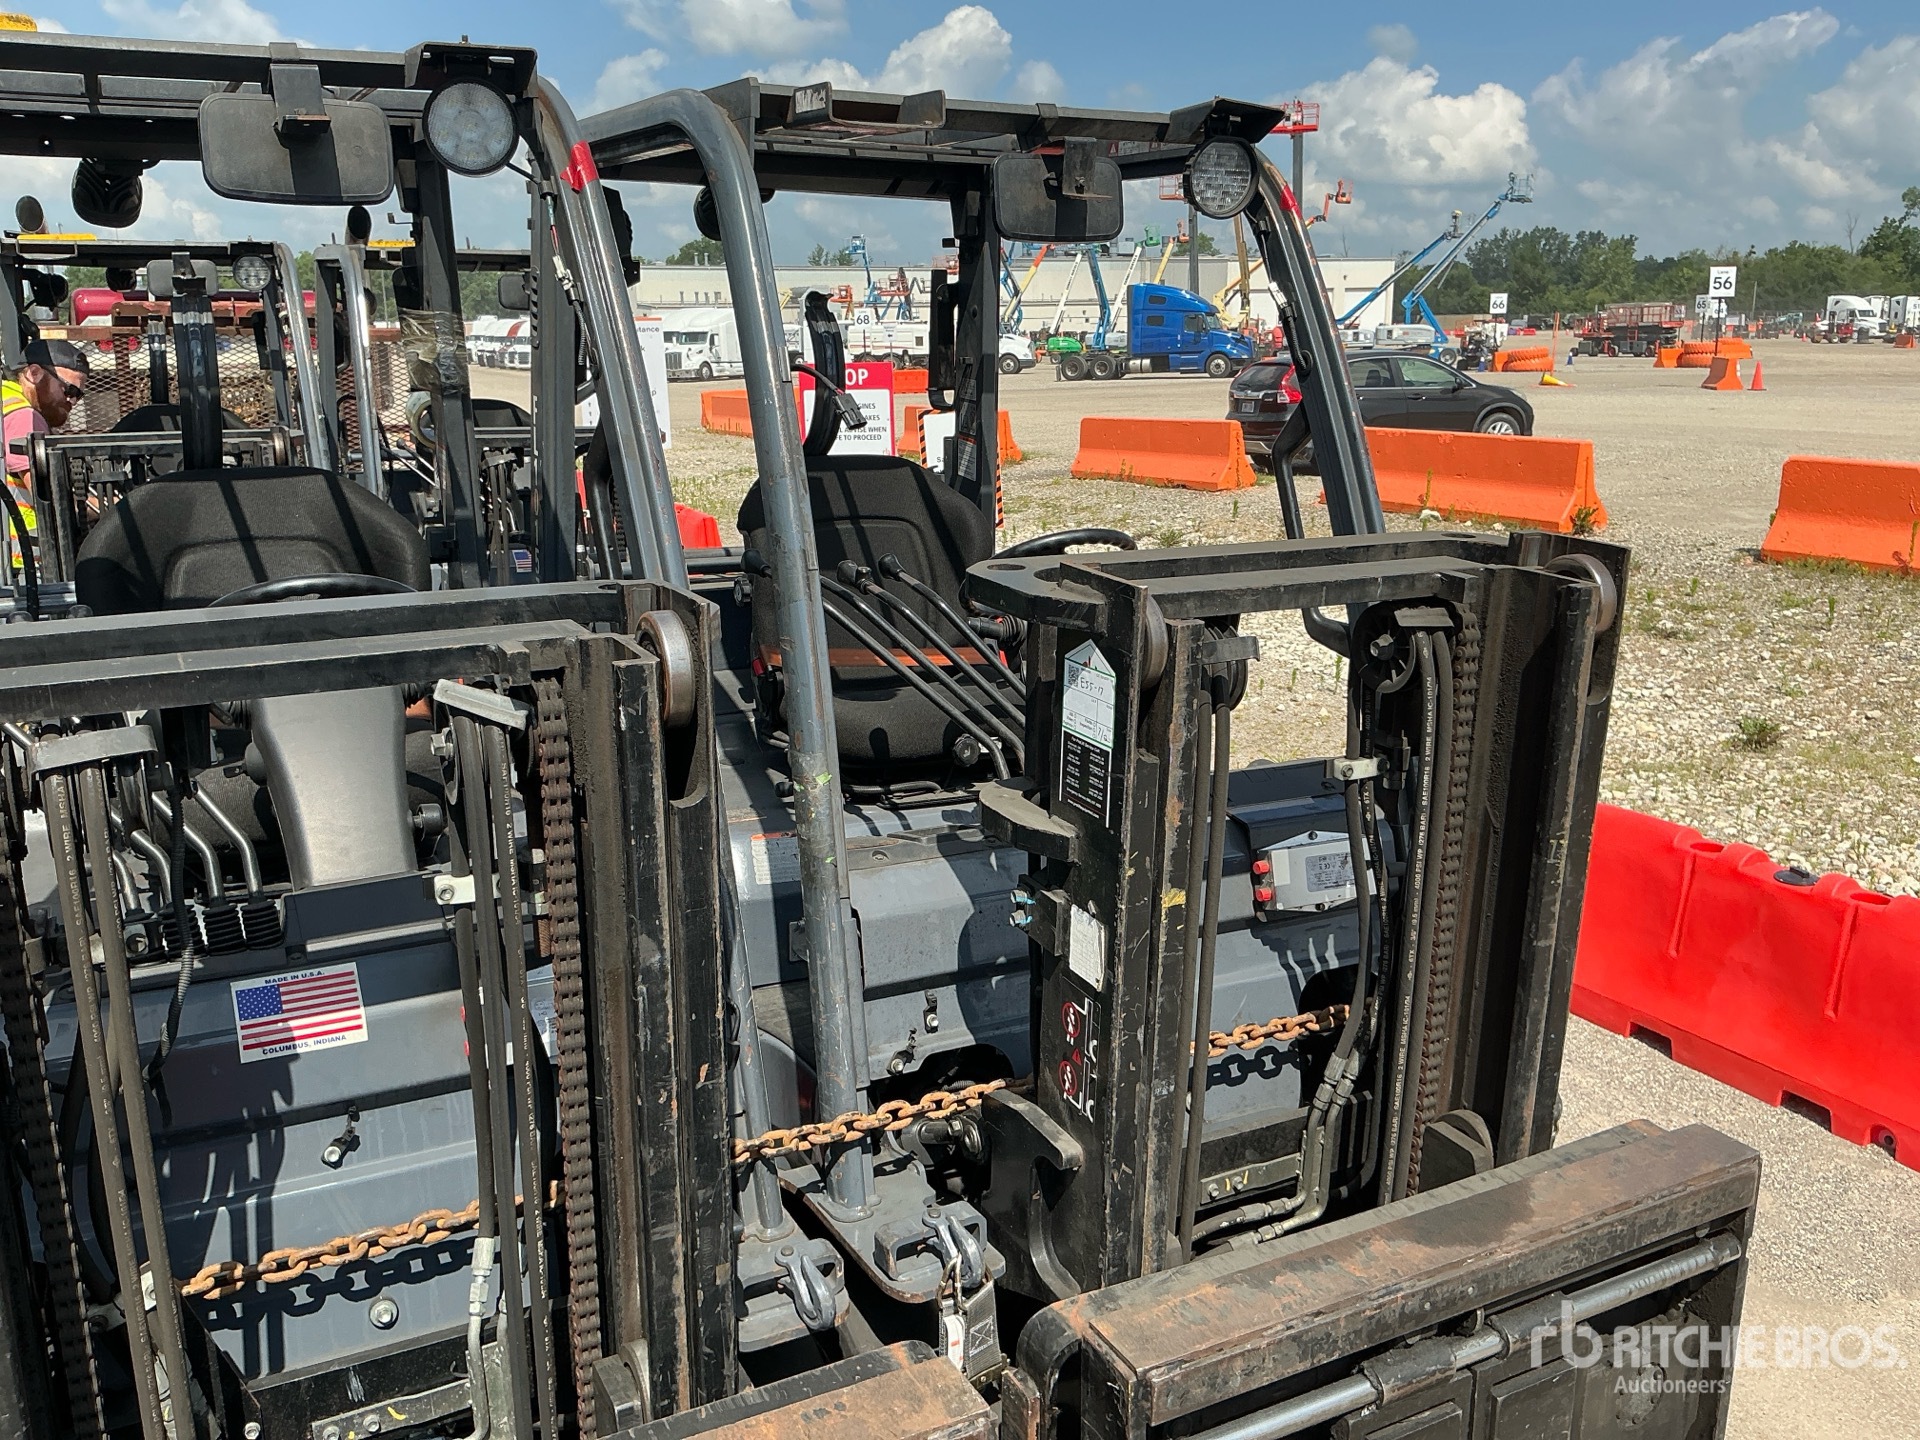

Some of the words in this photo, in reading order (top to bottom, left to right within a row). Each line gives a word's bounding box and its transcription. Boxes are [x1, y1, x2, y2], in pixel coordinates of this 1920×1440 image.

[1713, 276, 1733, 290] 56
[1492, 299, 1505, 309] 66
[1696, 300, 1706, 309] 65
[856, 315, 870, 325] 68
[845, 368, 869, 386] OP
[264, 976, 289, 985] MADE
[301, 970, 325, 979] U.S.A.
[262, 1042, 312, 1055] COLUMBUS,
[313, 1034, 347, 1046] INDIANA
